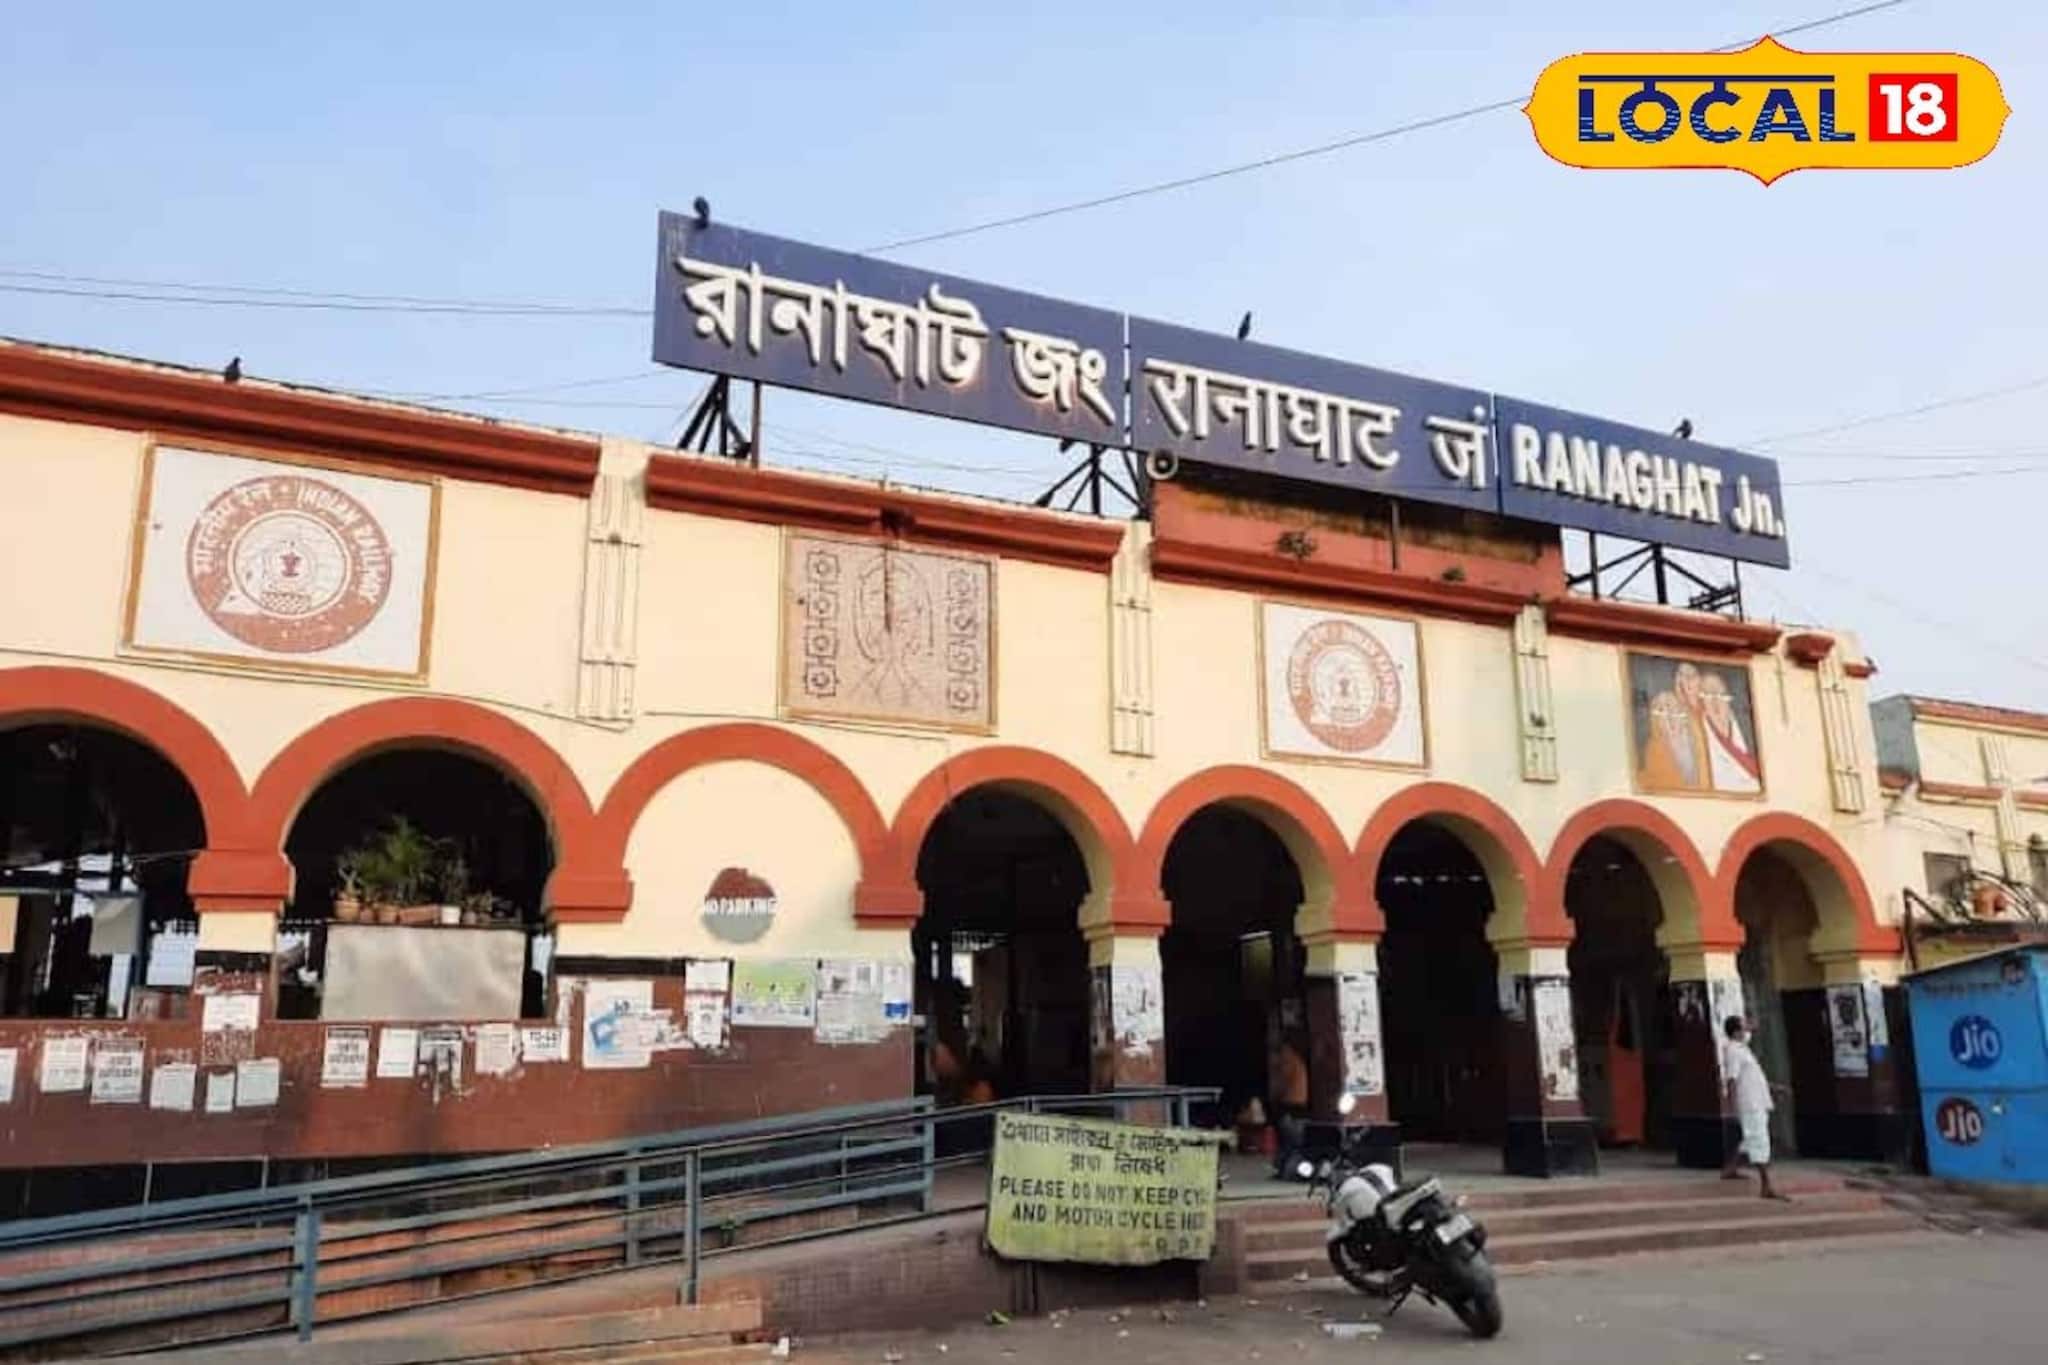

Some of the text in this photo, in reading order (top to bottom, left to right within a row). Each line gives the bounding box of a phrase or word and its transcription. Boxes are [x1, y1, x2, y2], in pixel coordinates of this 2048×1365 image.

[676, 256, 1116, 425] রানাঘাট জং
[1143, 357, 1490, 489] रानाघाट जं
[1513, 425, 1785, 538] RANAGHAT Jn.
[1957, 1022, 1999, 1062] Jio
[1943, 1105, 1982, 1141] Jio
[1000, 1177, 1065, 1199] PLEASE
[1072, 1183, 1090, 1199] DO
[1096, 1185, 1125, 1202] NOT
[1133, 1187, 1178, 1205] KEEP
[1012, 1203, 1047, 1223] AND
[1055, 1206, 1113, 1228] MOTOR
[1118, 1211, 1177, 1229] CYCLE
